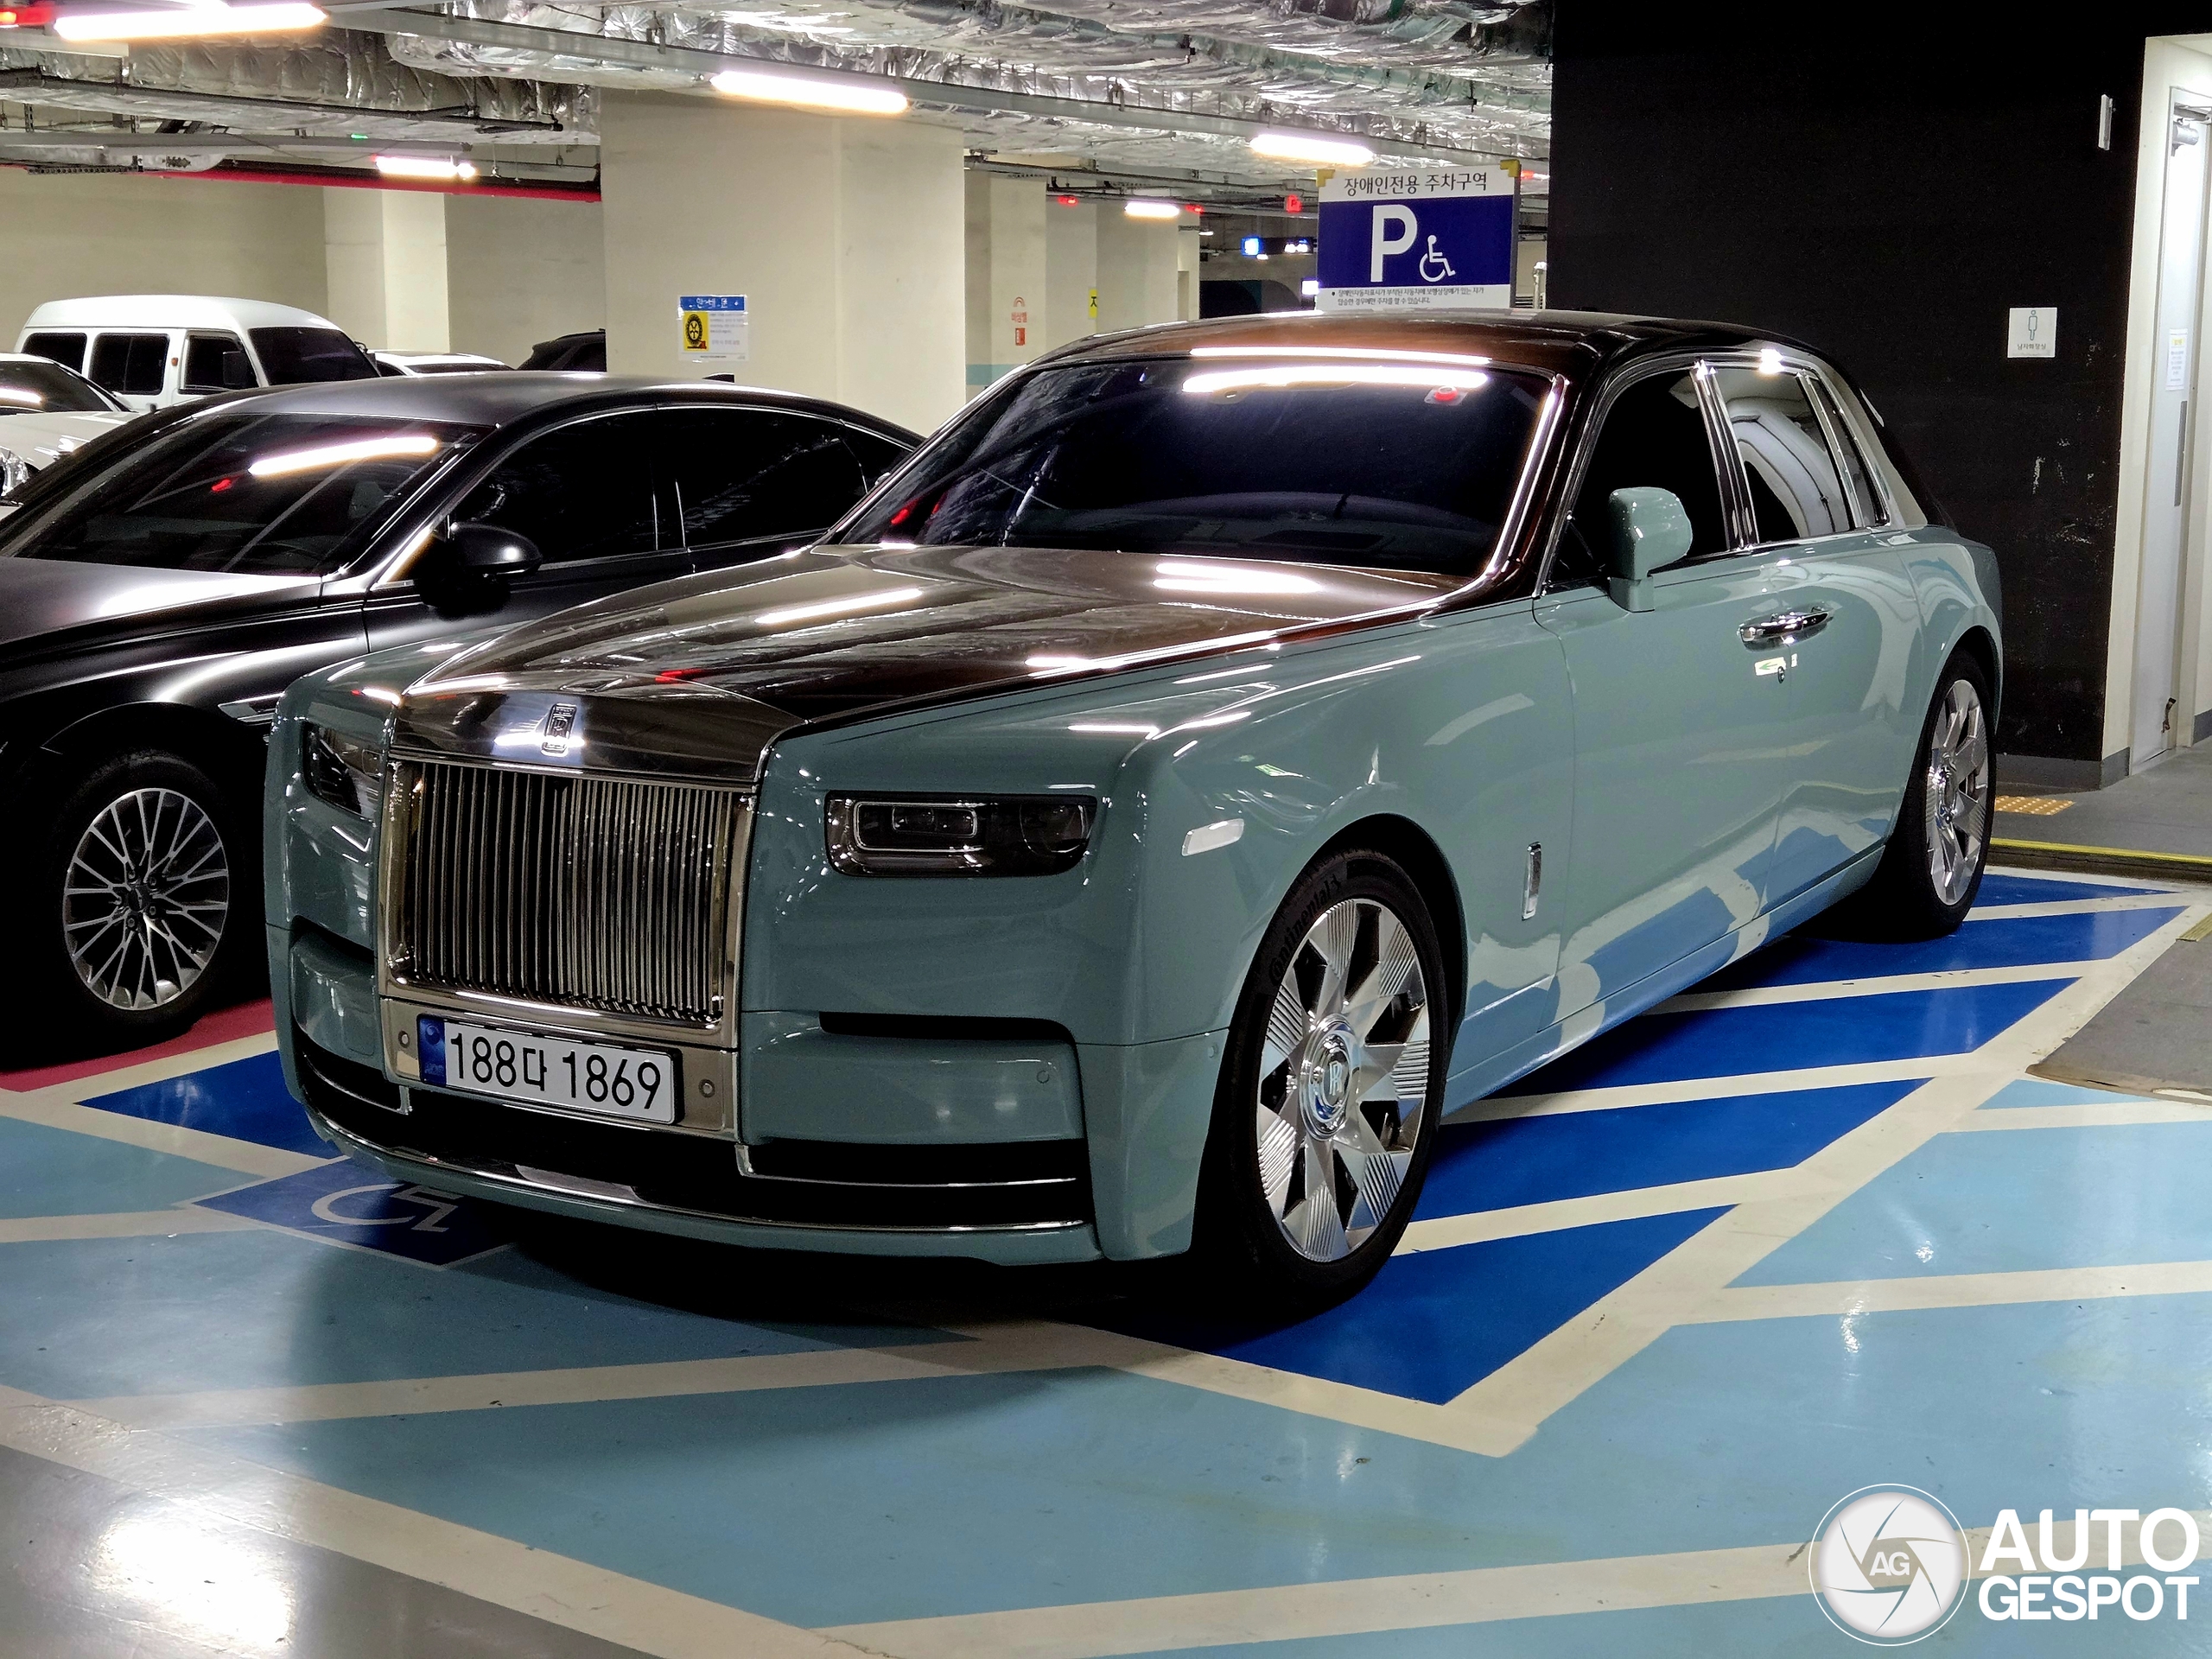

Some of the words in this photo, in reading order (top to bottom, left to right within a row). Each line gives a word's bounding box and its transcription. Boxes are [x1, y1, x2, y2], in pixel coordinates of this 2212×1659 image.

[1344, 175, 1420, 197] 장애인전용
[1425, 172, 1487, 192] 주차구역
[1370, 204, 1418, 283] P
[1268, 880, 1332, 986] Continental
[451, 1033, 547, 1091] 188다
[562, 1051, 662, 1110] 1869
